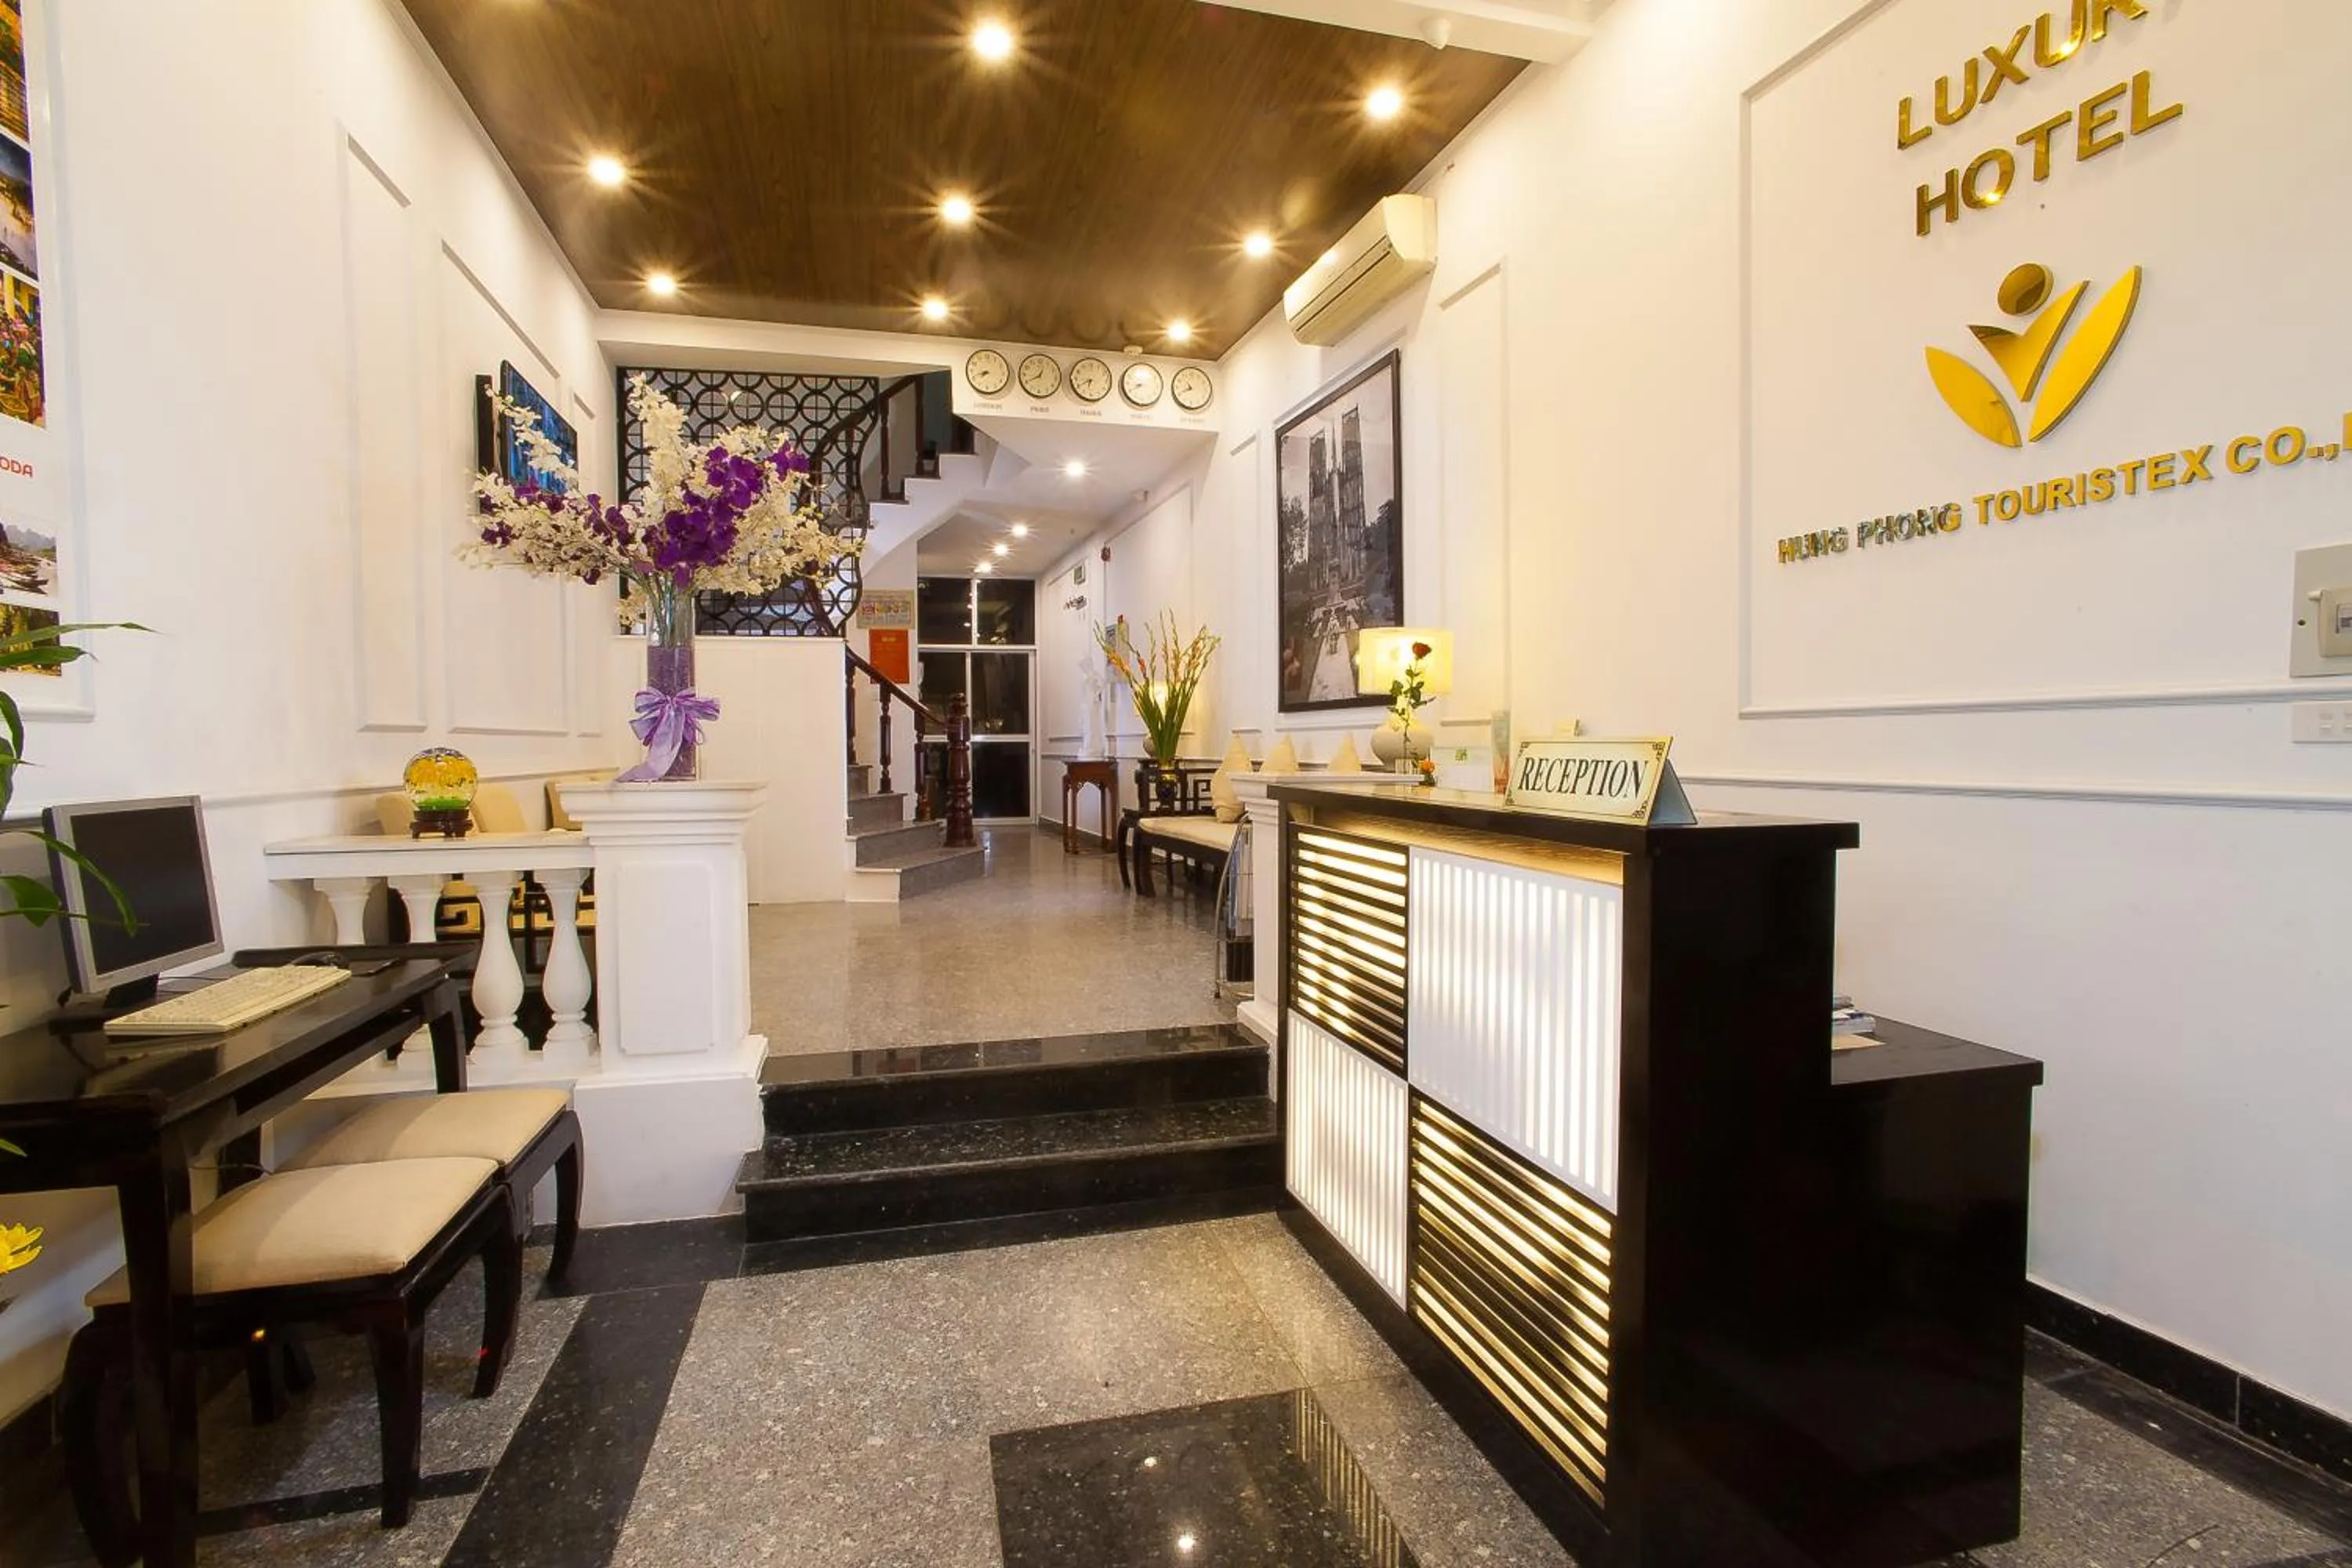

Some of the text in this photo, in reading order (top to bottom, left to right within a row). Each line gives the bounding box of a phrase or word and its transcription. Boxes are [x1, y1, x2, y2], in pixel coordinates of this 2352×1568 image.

[1916, 70, 2183, 237] HOTEL
[1778, 526, 1849, 563] HUNG
[1857, 502, 1962, 548] PHONG
[1973, 444, 2215, 525] TOURISTEX
[1518, 757, 1648, 799] RECEPTION
